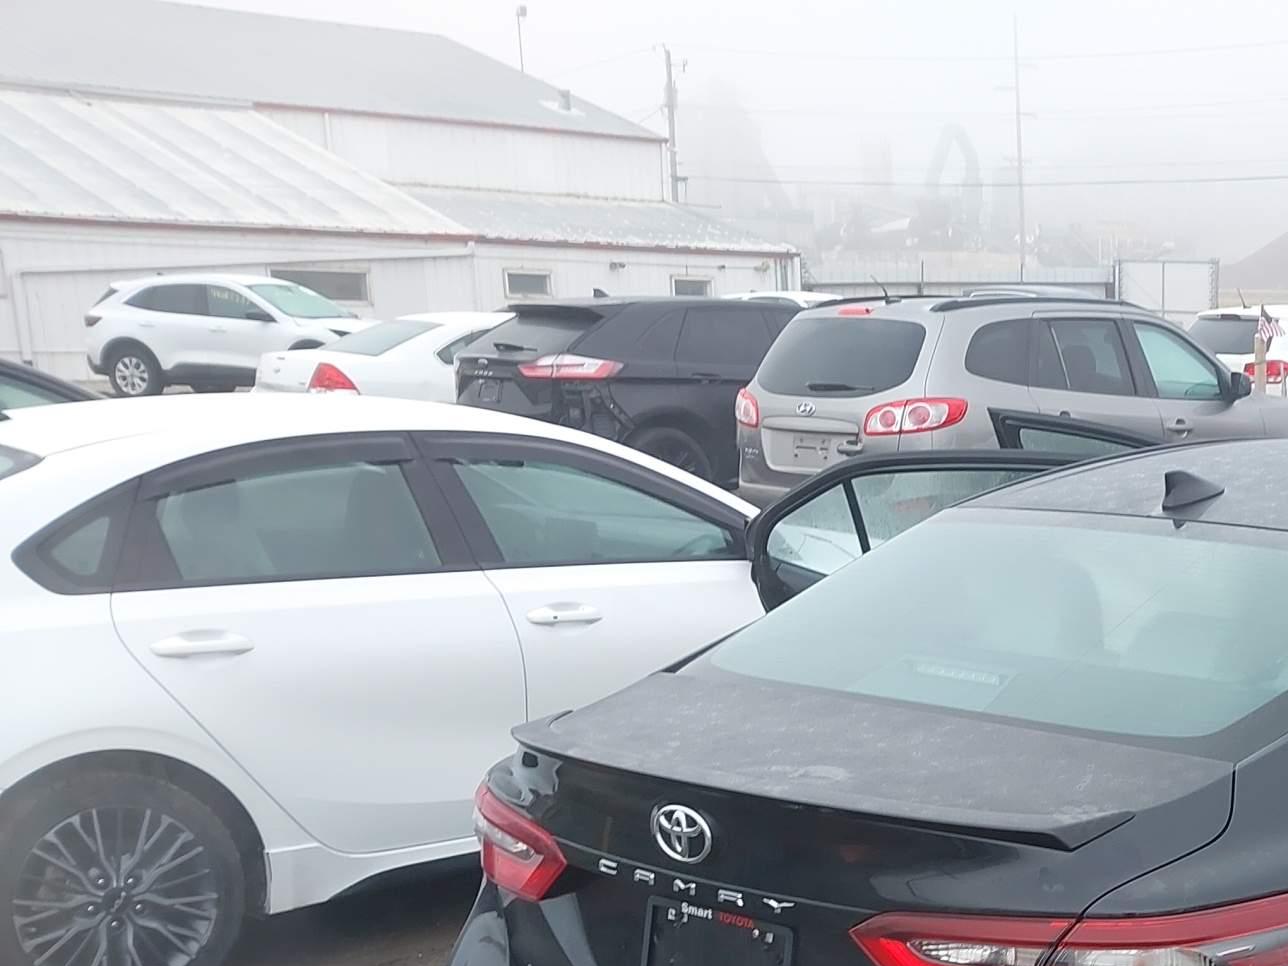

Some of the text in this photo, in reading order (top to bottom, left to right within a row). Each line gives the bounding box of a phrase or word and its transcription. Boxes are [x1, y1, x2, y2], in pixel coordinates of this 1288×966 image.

[598, 858, 796, 914] CAMRY
[680, 901, 755, 930] Smart TOYOTA
